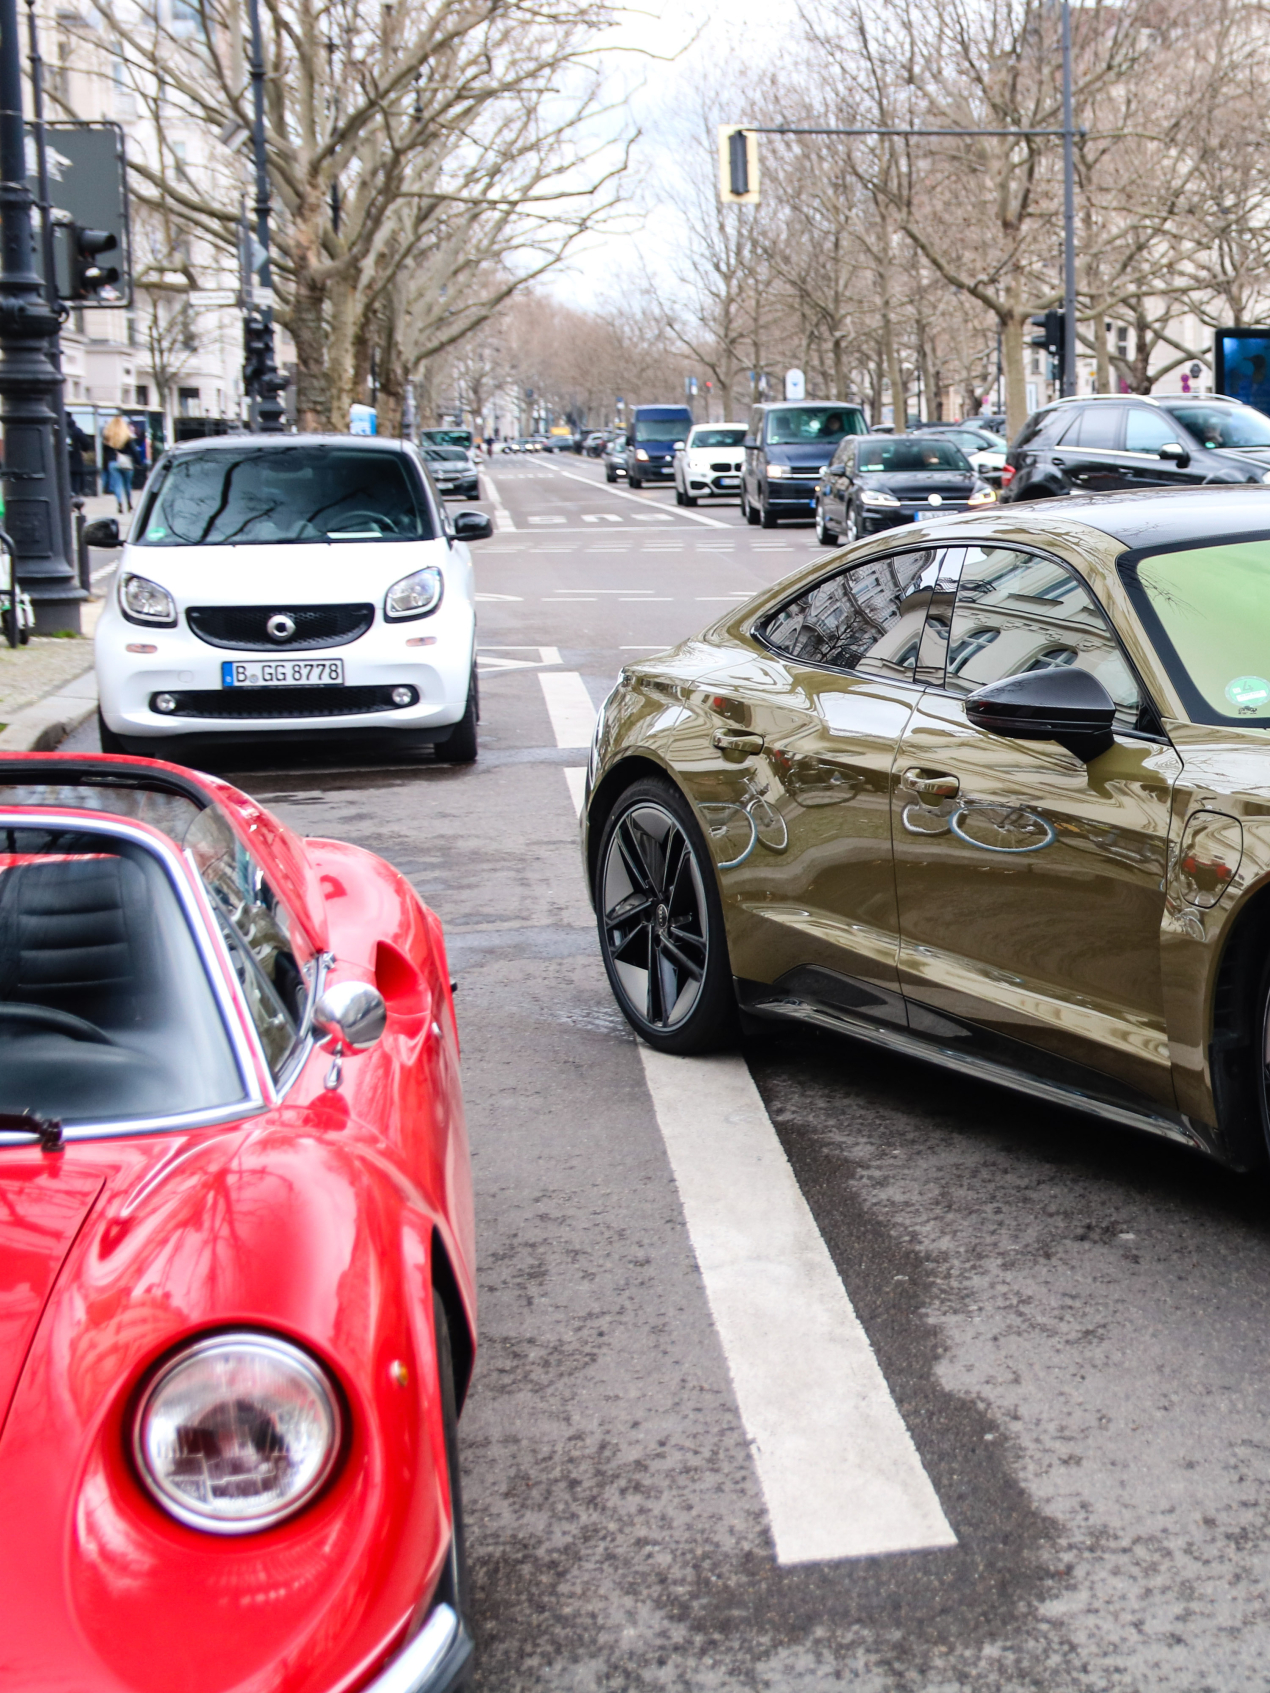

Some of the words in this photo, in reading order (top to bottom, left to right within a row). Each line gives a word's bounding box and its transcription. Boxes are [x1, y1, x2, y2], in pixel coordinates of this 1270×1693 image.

[235, 665, 248, 683] B
[261, 664, 287, 682] GG
[291, 662, 340, 681] 8778
